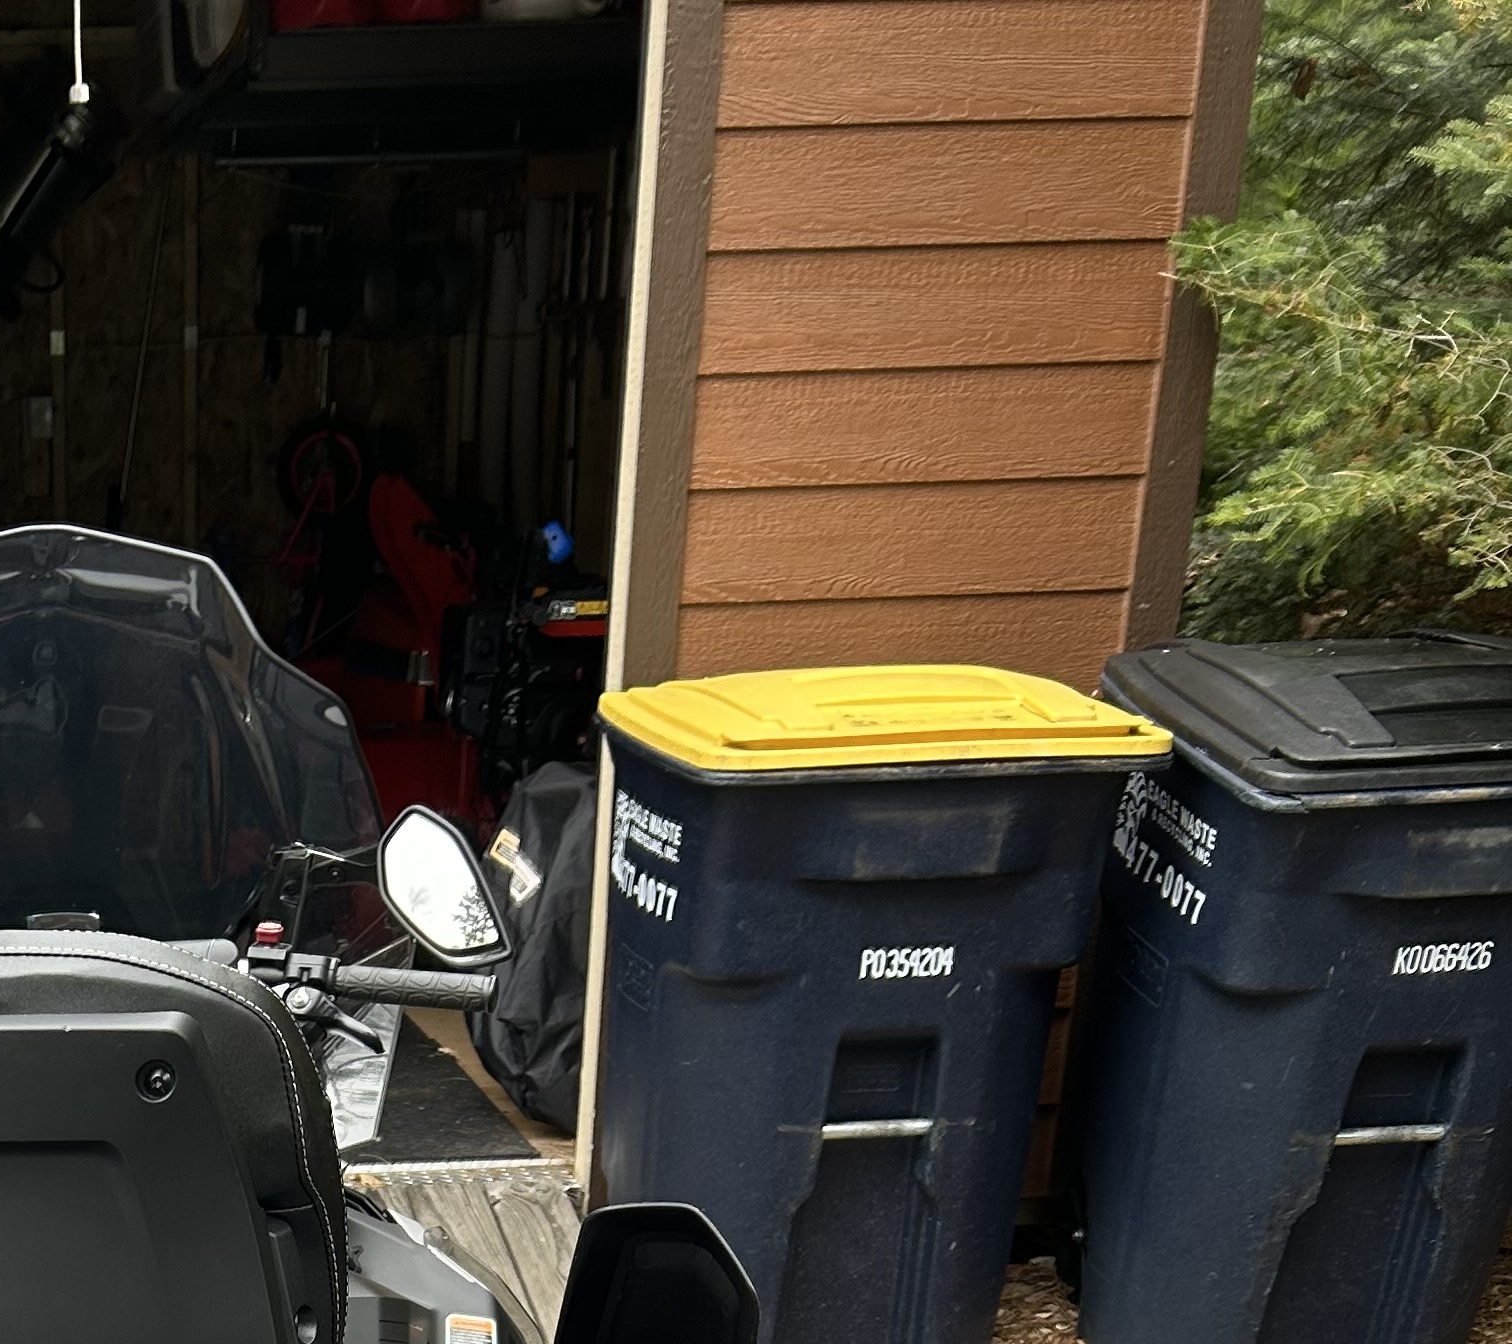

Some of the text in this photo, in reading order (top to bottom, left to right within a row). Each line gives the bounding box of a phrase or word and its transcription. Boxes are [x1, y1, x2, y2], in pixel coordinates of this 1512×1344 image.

[1148, 779, 1218, 851] EAGLE WASTE
[1124, 836, 1207, 925] 477-0077
[1391, 940, 1495, 976] K0066426
